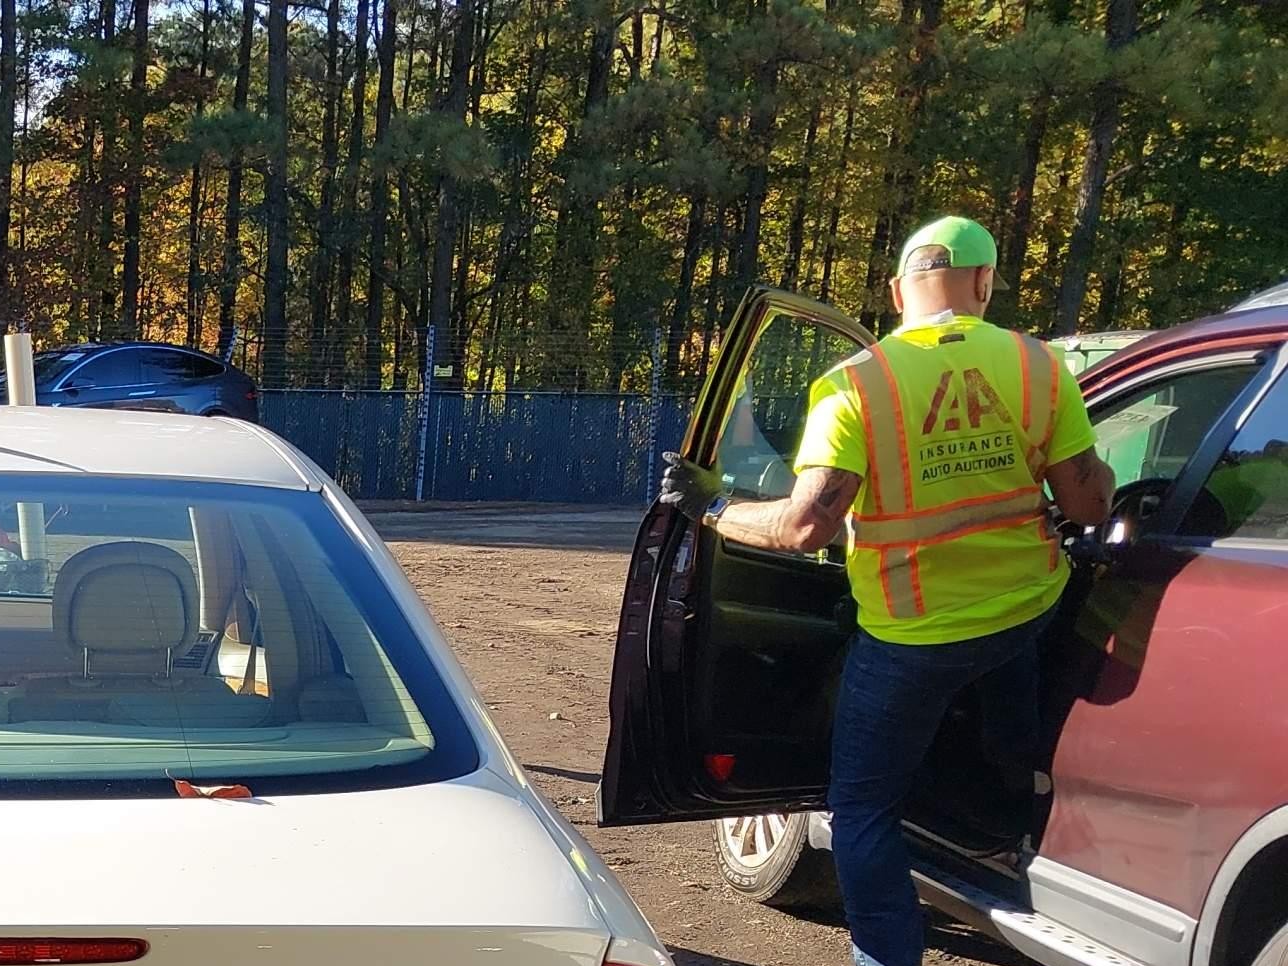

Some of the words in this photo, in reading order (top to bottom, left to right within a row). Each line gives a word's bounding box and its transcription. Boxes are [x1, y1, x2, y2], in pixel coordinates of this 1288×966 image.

[919, 434, 1014, 461] INSURANCE
[921, 463, 951, 481] AUTO
[953, 453, 1016, 473] AUCTIONS
